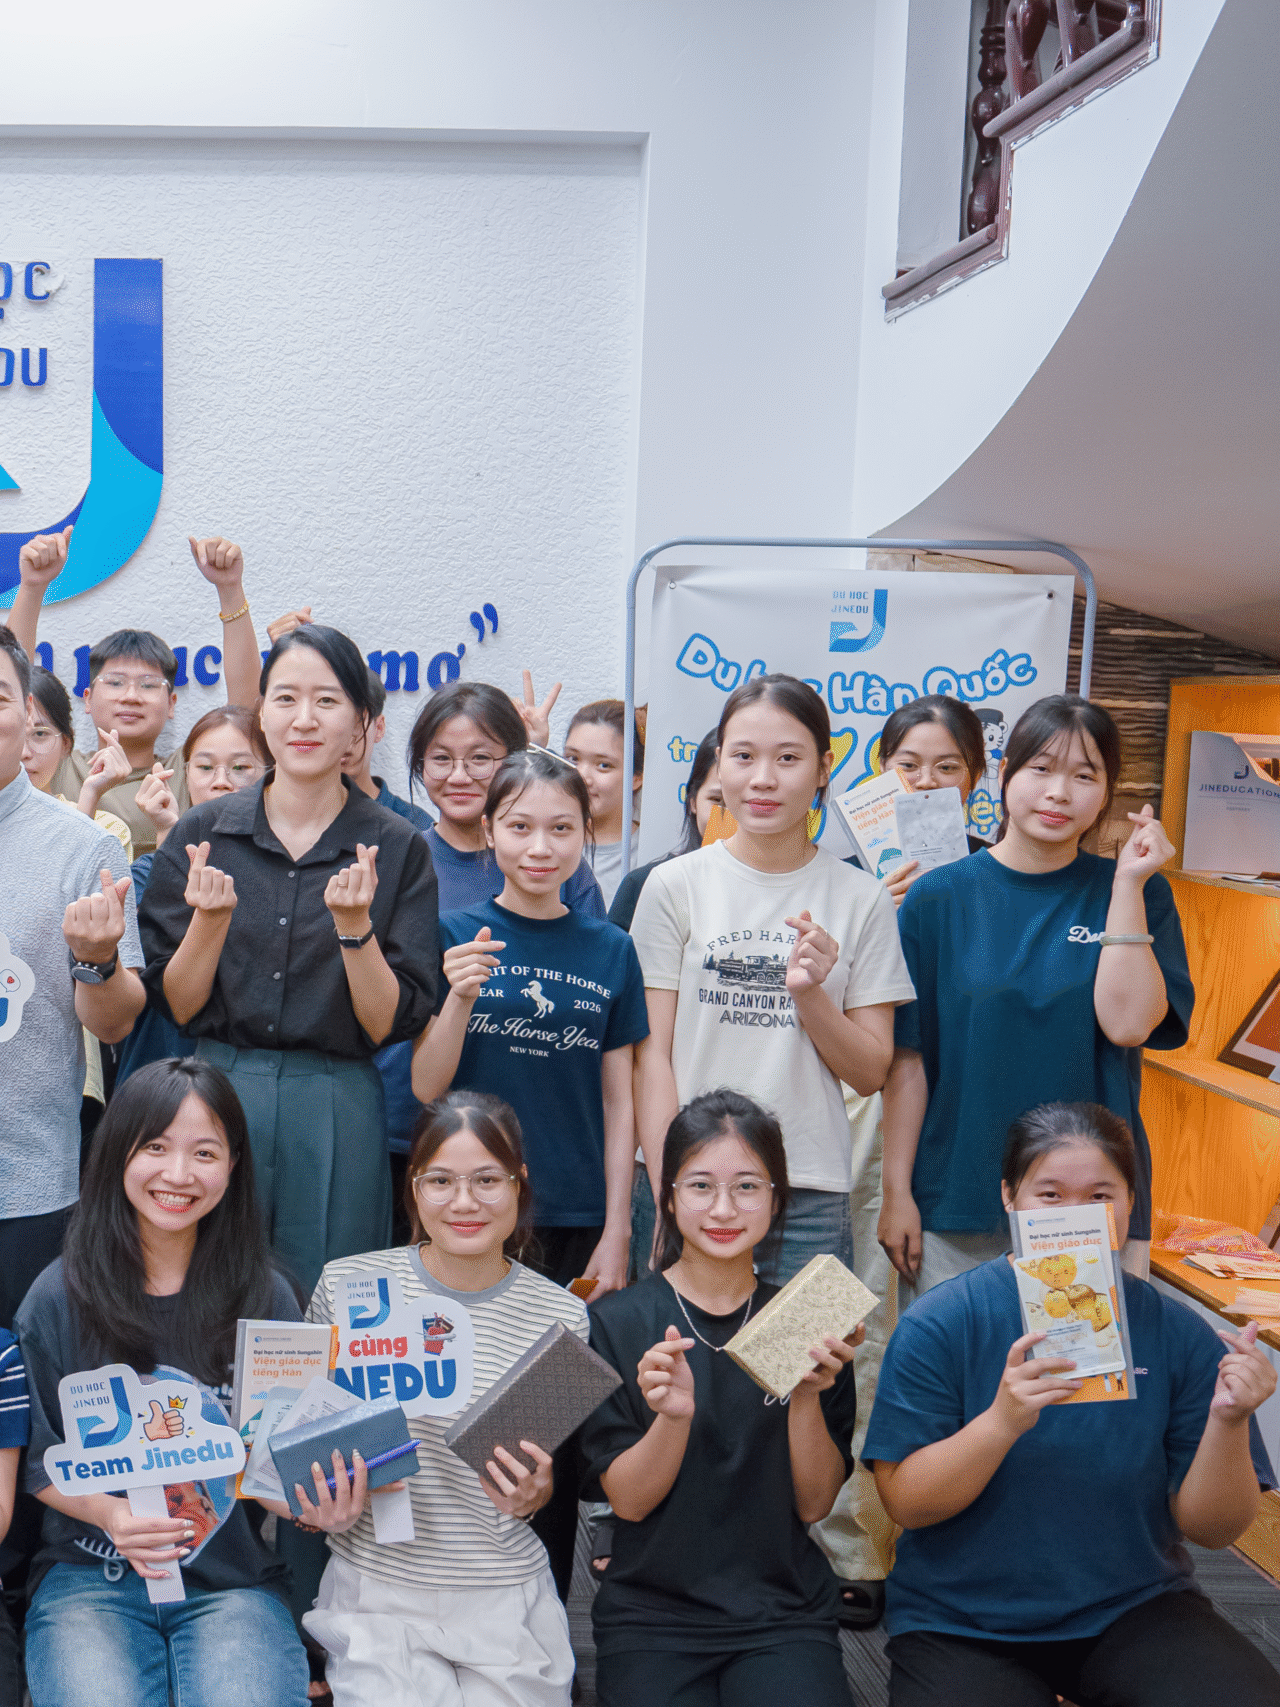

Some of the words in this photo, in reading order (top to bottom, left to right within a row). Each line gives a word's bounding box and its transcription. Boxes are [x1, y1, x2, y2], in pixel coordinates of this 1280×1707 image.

[830, 604, 869, 614] JINEDU
[676, 632, 742, 692] Du
[827, 671, 920, 717] Hàn
[922, 648, 1038, 702] Quốc
[706, 929, 753, 951] FRED
[511, 965, 531, 976] OF
[533, 966, 563, 982] THE
[565, 973, 612, 1000] HORSE
[478, 987, 504, 998] EAR
[698, 988, 729, 1006] GRAND
[732, 991, 775, 1010] CANYON
[573, 999, 602, 1014] 2026
[719, 1009, 796, 1029] ARIZONA
[467, 1013, 500, 1034] The
[500, 1017, 559, 1043] Horse
[509, 1045, 528, 1054] NEW
[528, 1047, 550, 1058] YORK
[1030, 1240, 1055, 1252] Viện
[1057, 1238, 1081, 1250] giáo
[348, 1333, 408, 1359] cùng
[253, 1356, 276, 1367] Viện
[278, 1356, 301, 1368] giáo
[303, 1356, 322, 1368] dục
[252, 1368, 279, 1378] tiếng
[282, 1368, 302, 1377] Hàn
[334, 1358, 457, 1402] NEDU
[70, 1385, 84, 1395] DU
[73, 1395, 110, 1409] JINEDU
[55, 1456, 134, 1482] Team
[141, 1439, 235, 1471] Jinedu
